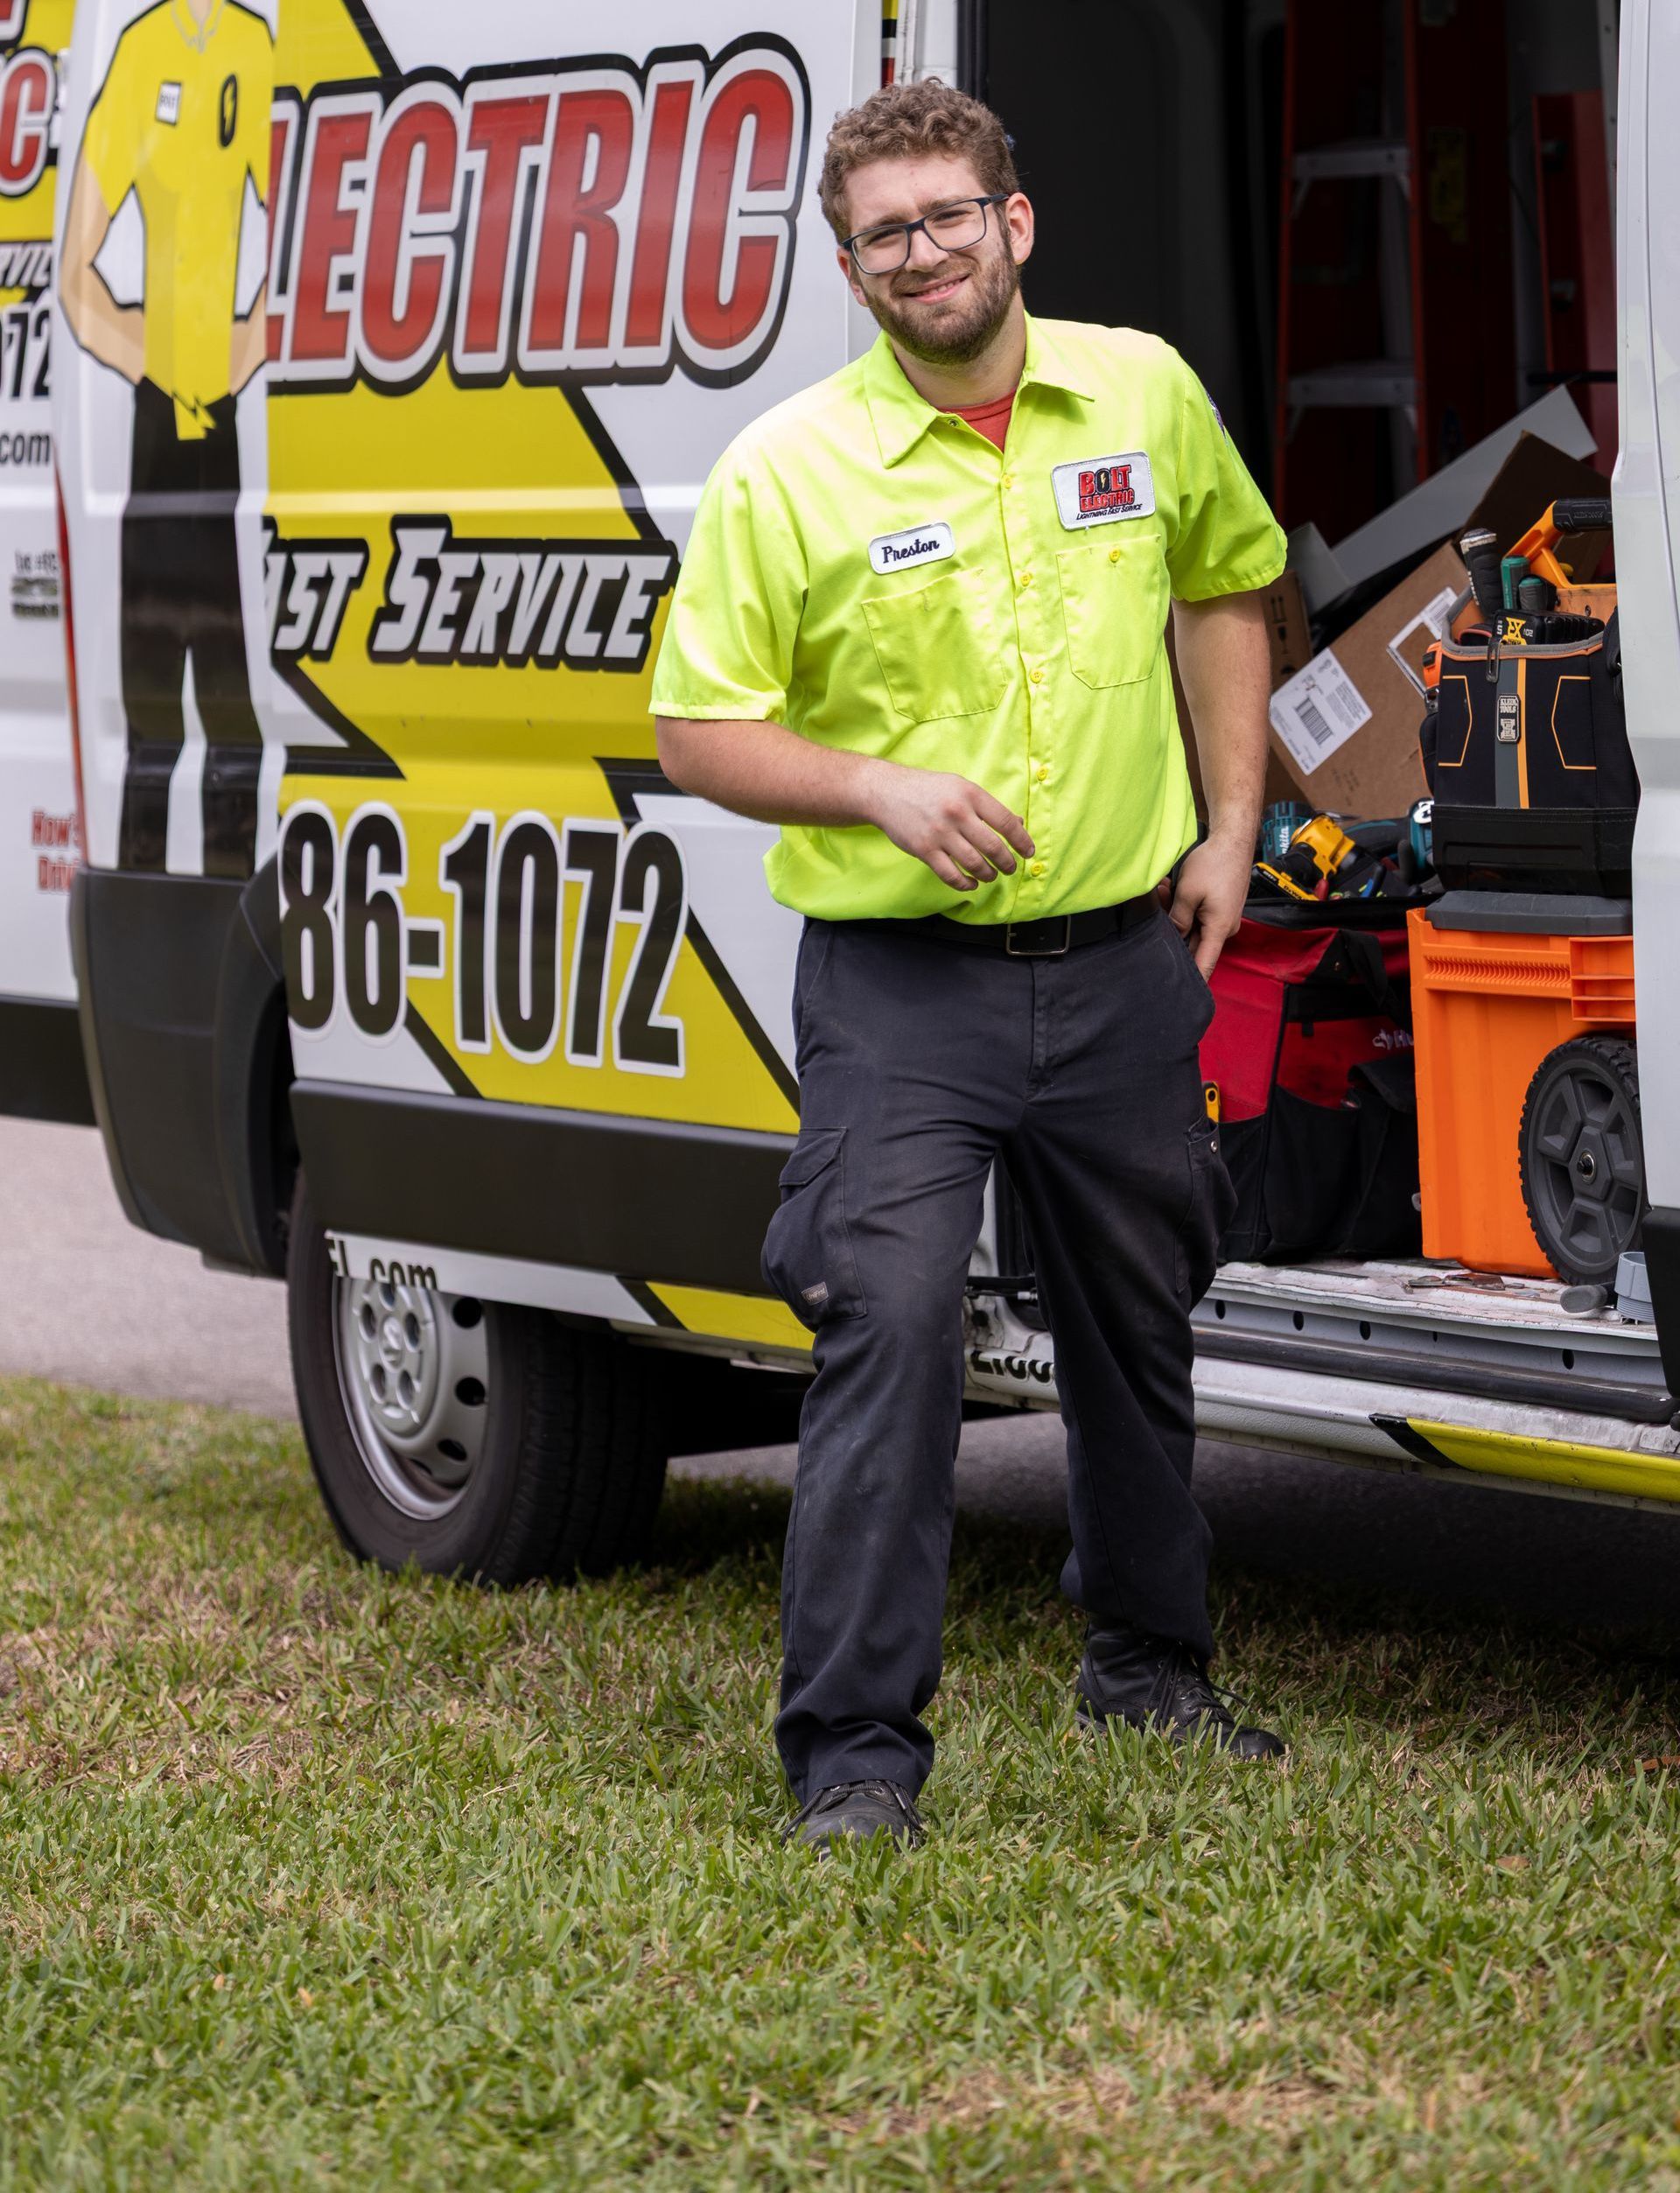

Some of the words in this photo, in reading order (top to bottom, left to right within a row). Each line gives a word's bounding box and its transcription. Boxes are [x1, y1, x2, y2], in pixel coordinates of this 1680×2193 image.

[0, 309, 50, 398] 72
[1078, 464, 1132, 497] BOLT
[1079, 488, 1136, 513] ELECTRIC
[881, 538, 941, 564] Preston
[372, 528, 671, 658] SERVICE
[280, 811, 684, 1067] 86-1072
